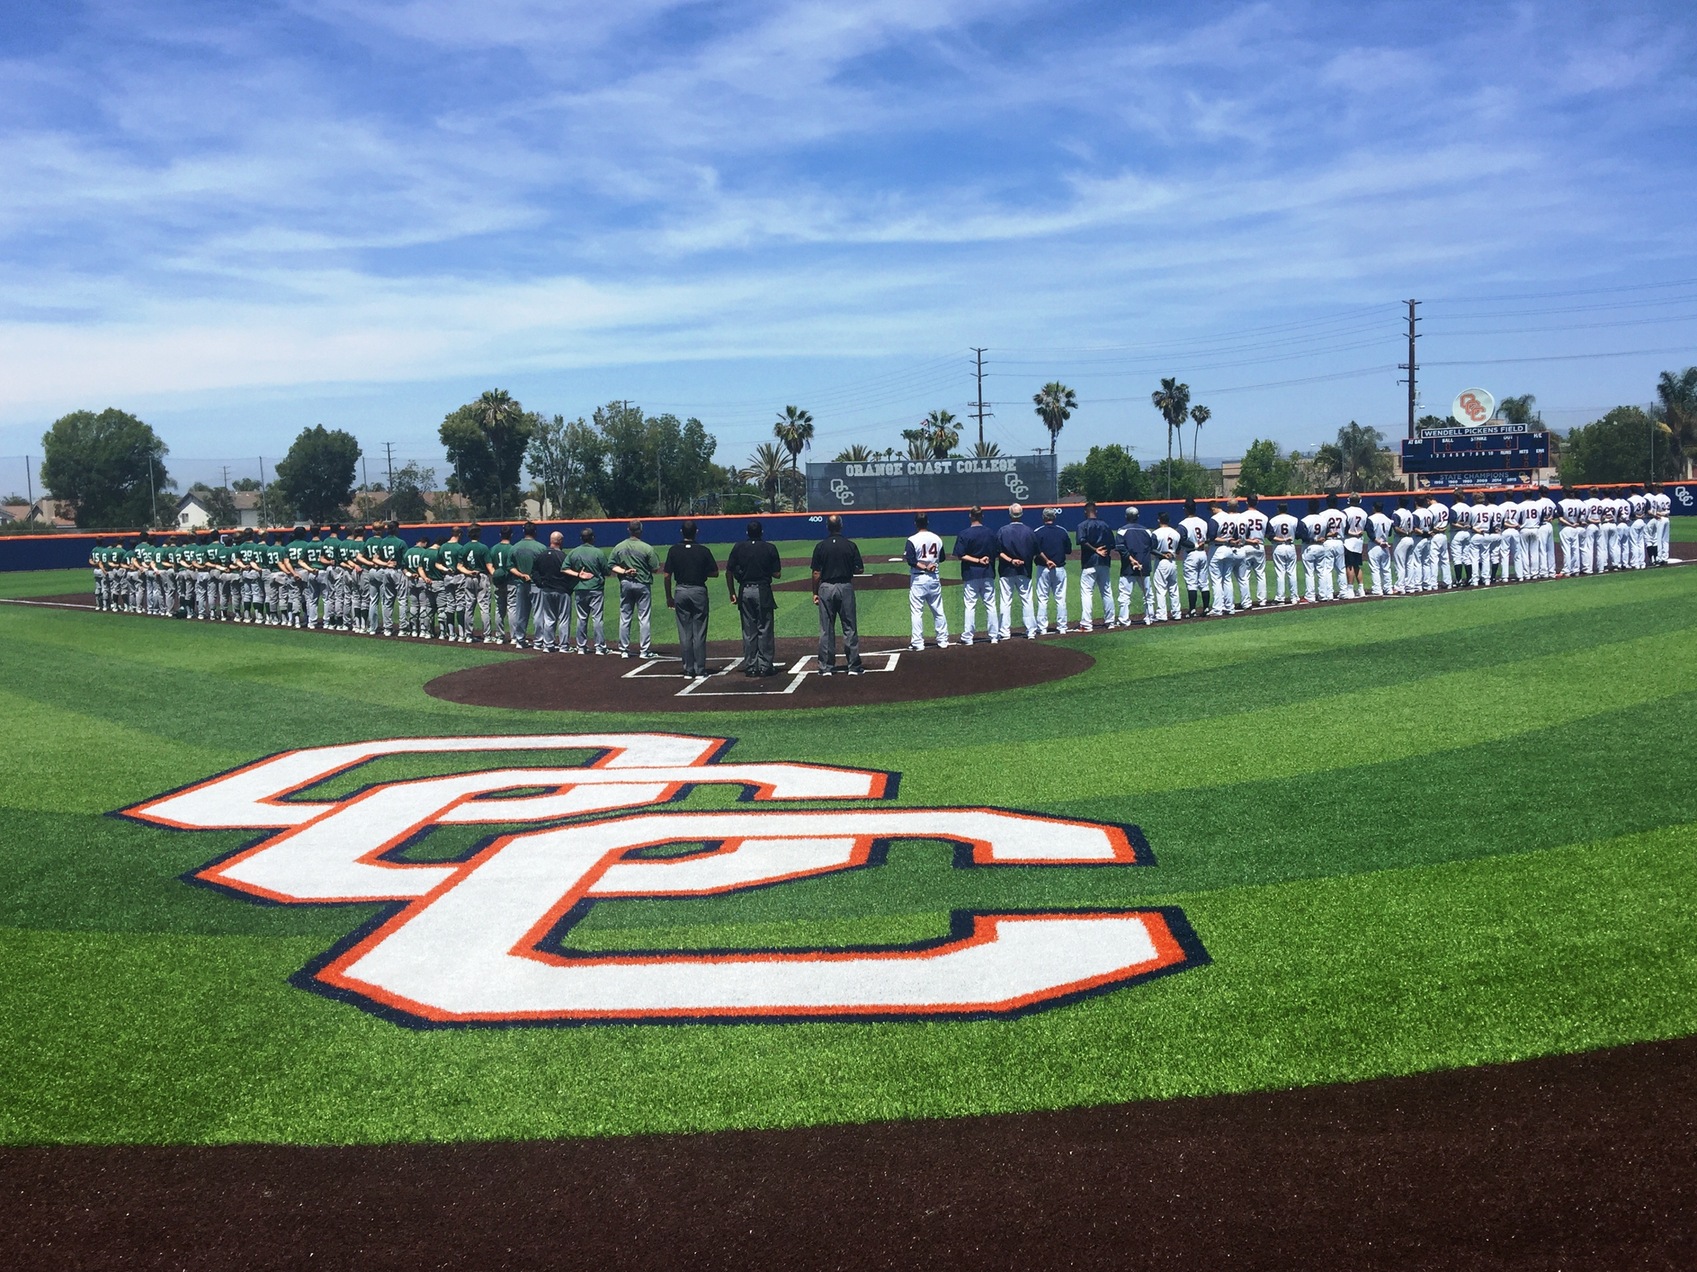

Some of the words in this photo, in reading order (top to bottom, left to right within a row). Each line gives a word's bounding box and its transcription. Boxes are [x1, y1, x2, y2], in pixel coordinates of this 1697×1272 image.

[1460, 393, 1486, 421] OCC
[1424, 428, 1463, 437] WENDELL
[1465, 426, 1499, 434] PICKENS
[1500, 425, 1523, 433] FIELD
[846, 463, 903, 477] ORANGE
[907, 461, 951, 475] COAST
[956, 458, 1016, 473] COLLEGE
[1464, 471, 1509, 479] CHAMPIONS
[830, 478, 855, 505] OCC
[1004, 473, 1029, 500] OCC
[1675, 486, 1694, 506] OCC
[1438, 511, 1448, 522] 12
[1476, 512, 1489, 523] 15
[1506, 509, 1517, 519] 17
[1526, 508, 1537, 519] 18
[1568, 507, 1577, 517] 21
[808, 515, 823, 523] 400
[1248, 518, 1263, 531] 25
[1328, 517, 1342, 529] 27
[1355, 516, 1362, 527] 7
[1424, 516, 1432, 527] 10
[1281, 523, 1289, 535] 6
[1314, 523, 1321, 535] 9
[1381, 523, 1386, 533] 1
[1167, 537, 1173, 549] 2
[383, 545, 395, 559] 12
[922, 543, 937, 558] 14
[156, 552, 161, 563] 8
[267, 552, 279, 564] 33
[407, 554, 420, 568] 10
[444, 550, 453, 565] 5
[498, 551, 503, 566] 1
[104, 732, 1210, 1029] OCC
